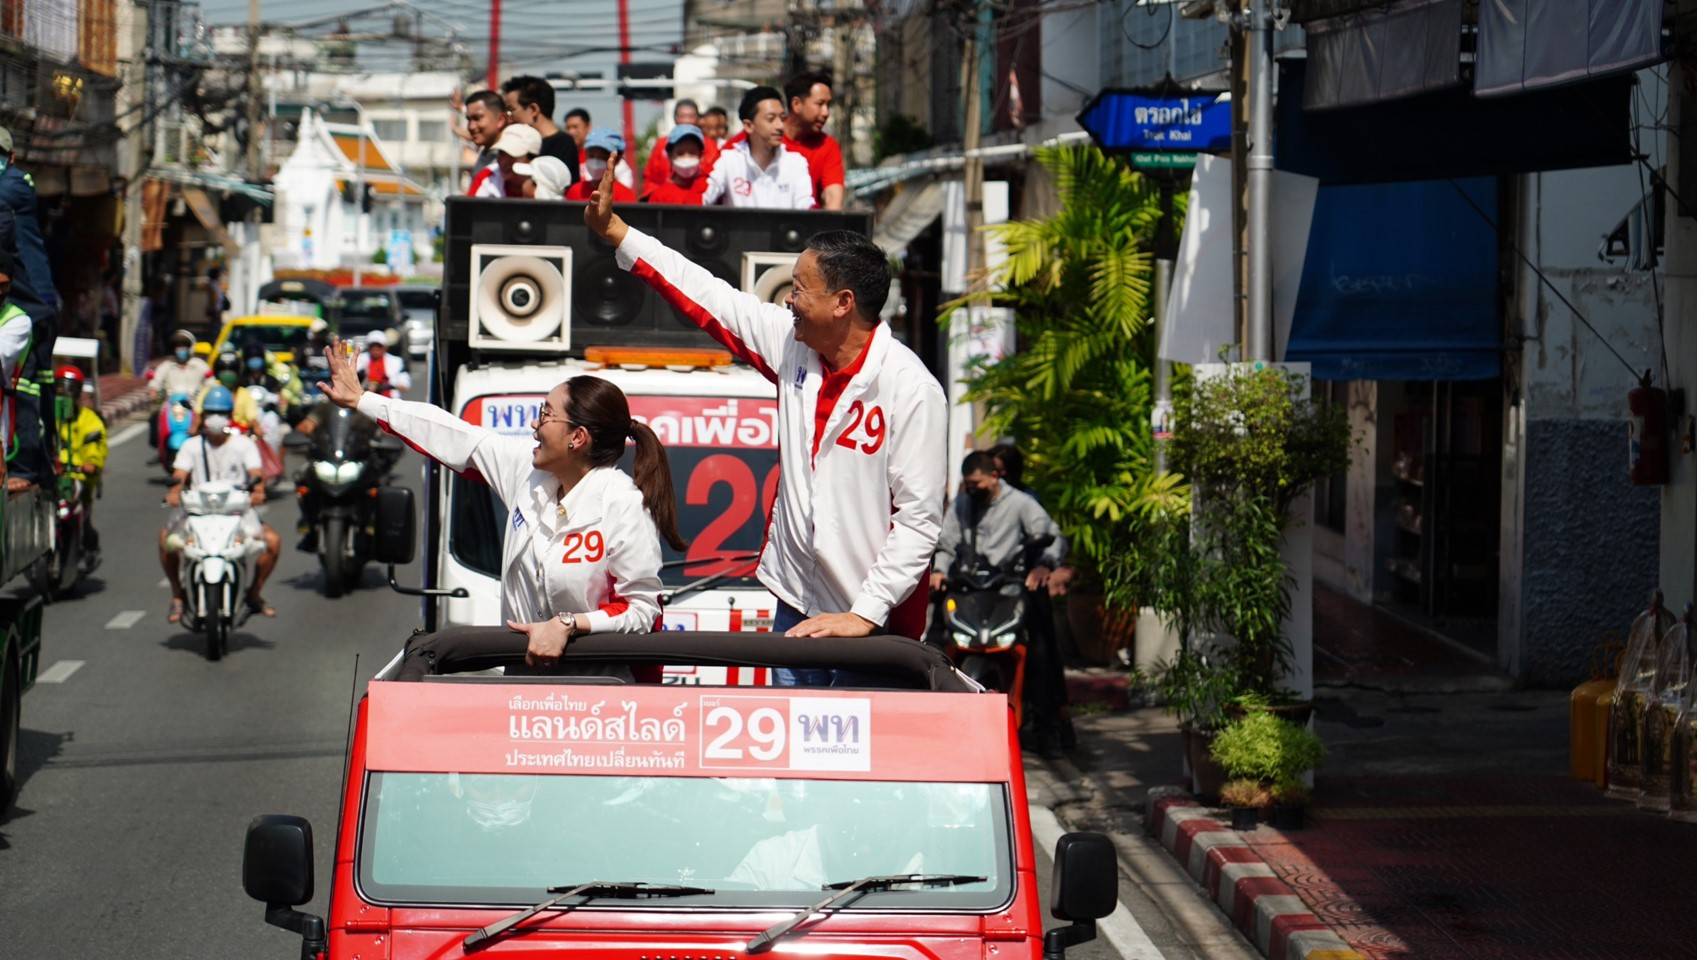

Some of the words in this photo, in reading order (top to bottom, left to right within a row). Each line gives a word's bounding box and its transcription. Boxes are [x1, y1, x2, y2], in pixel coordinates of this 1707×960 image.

[1135, 98, 1202, 125] ตรอกไข่
[1169, 129, 1192, 140] Khai
[836, 400, 886, 455] 29
[683, 453, 780, 577] 2
[562, 530, 604, 563] 29
[508, 692, 587, 711] เลือกเพื่อไทย
[508, 700, 688, 742] แลนด์สไลด์
[704, 706, 786, 761] 29
[798, 714, 859, 743] พท
[505, 748, 686, 769] ประเทศไทยเปลี่ยนทันที
